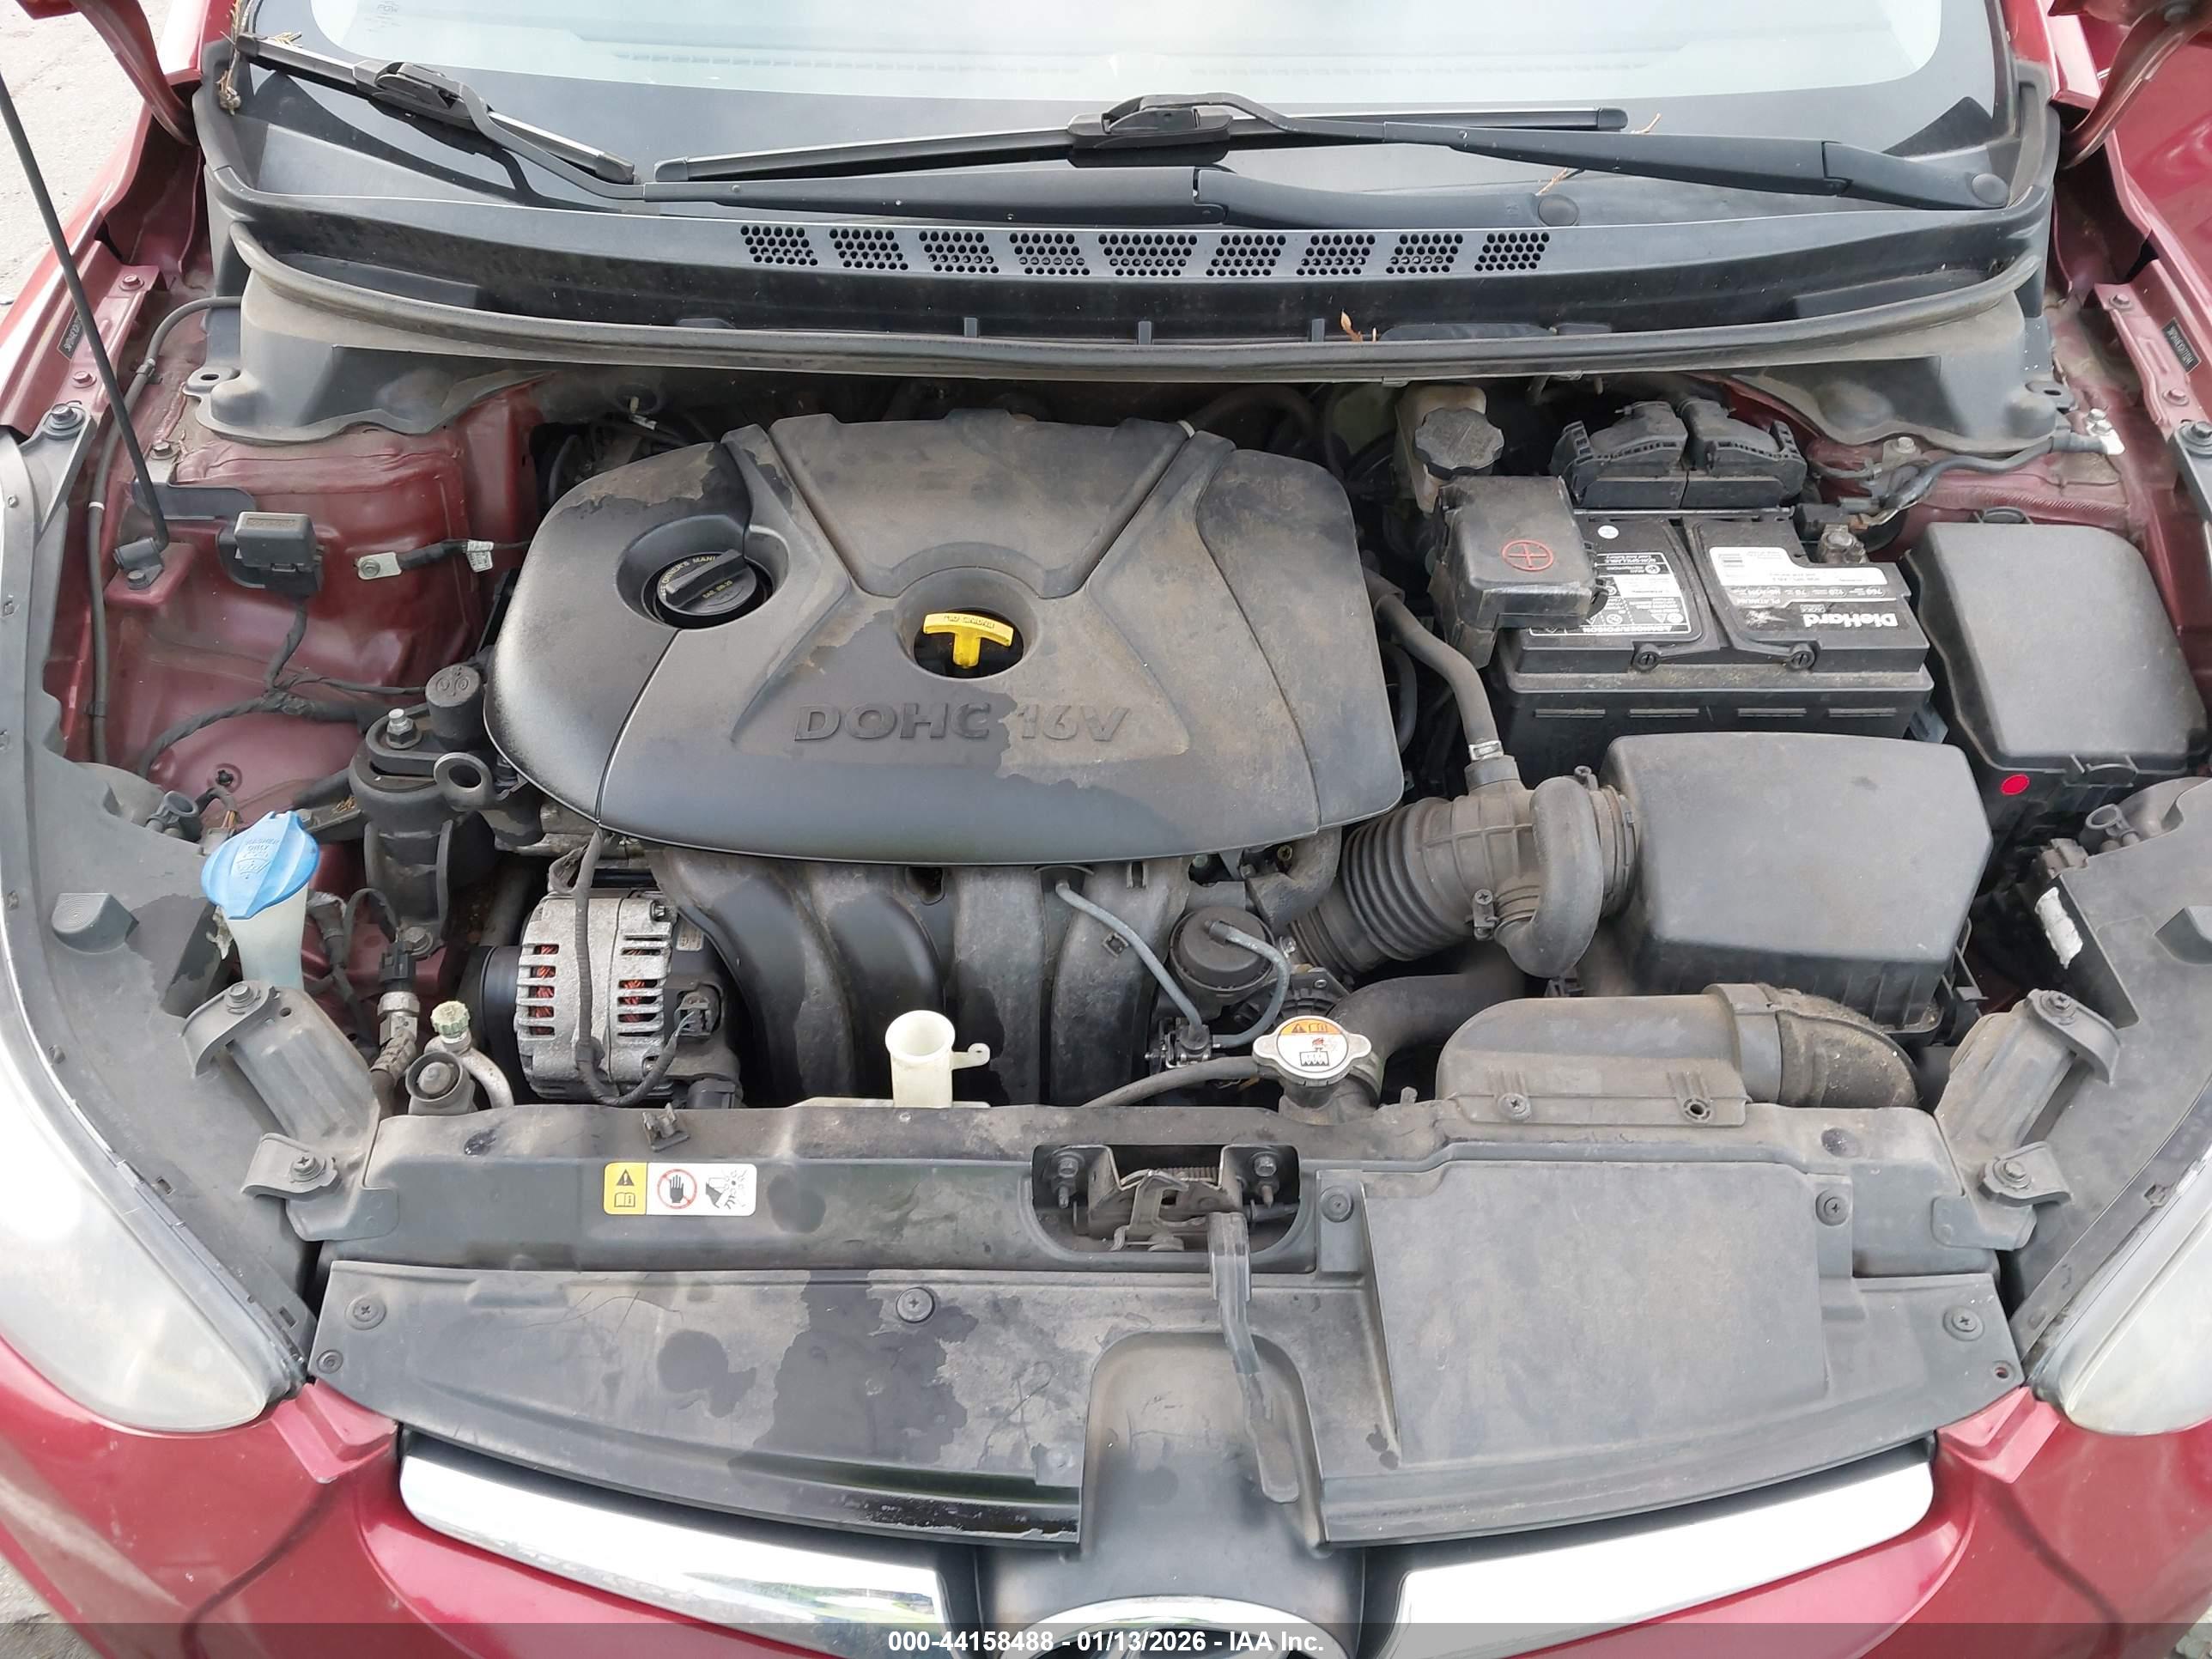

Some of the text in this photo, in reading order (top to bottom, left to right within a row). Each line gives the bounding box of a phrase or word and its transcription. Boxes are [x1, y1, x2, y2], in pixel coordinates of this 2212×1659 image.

[1804, 612, 1899, 628] DieHard
[793, 701, 1131, 742] DOHC 16V
